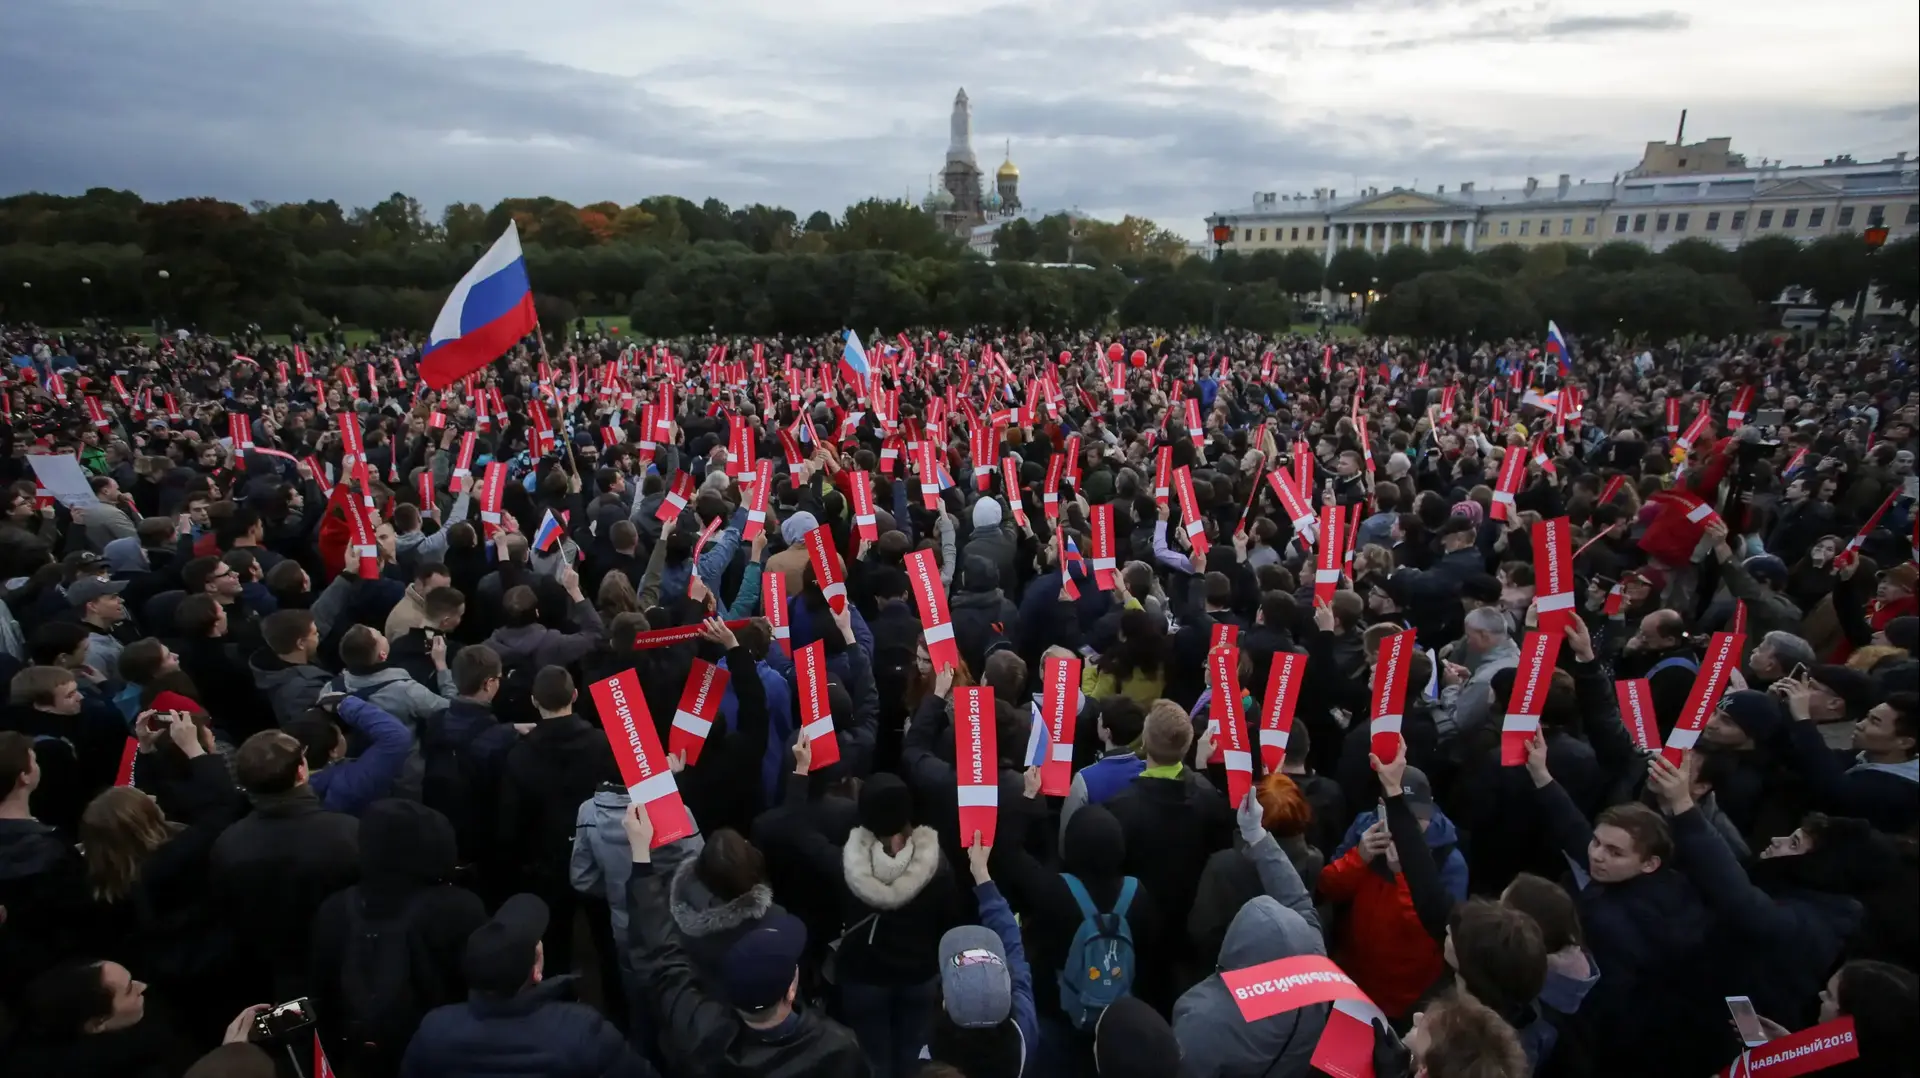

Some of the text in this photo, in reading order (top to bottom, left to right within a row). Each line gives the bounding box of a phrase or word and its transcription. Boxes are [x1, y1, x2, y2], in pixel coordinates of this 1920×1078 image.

[817, 543, 835, 585] НАВАЛЬНЫЙ
[1544, 540, 1559, 593] НАВАЛЬНЫЙ
[919, 572, 940, 625] НАВАЛЬНЫЙ
[807, 666, 822, 722] НАВАЛЬНЫЙ
[1051, 682, 1066, 742] НАВАЛЬНЫЙ
[1269, 674, 1289, 729] НАВАЛЬНЫЙ
[1520, 656, 1543, 713] НАВАЛЬНЫЙ
[1691, 661, 1724, 729] НАВАЛЬНЫЙ
[616, 704, 652, 778] НАВАЛЬНЫЙ
[1220, 681, 1240, 750] НАВАЛЬНЫЙ
[969, 714, 983, 783] НАВАЛЬНЫЙ
[1751, 1038, 1823, 1071] НАВАЛЬНЫЙ
